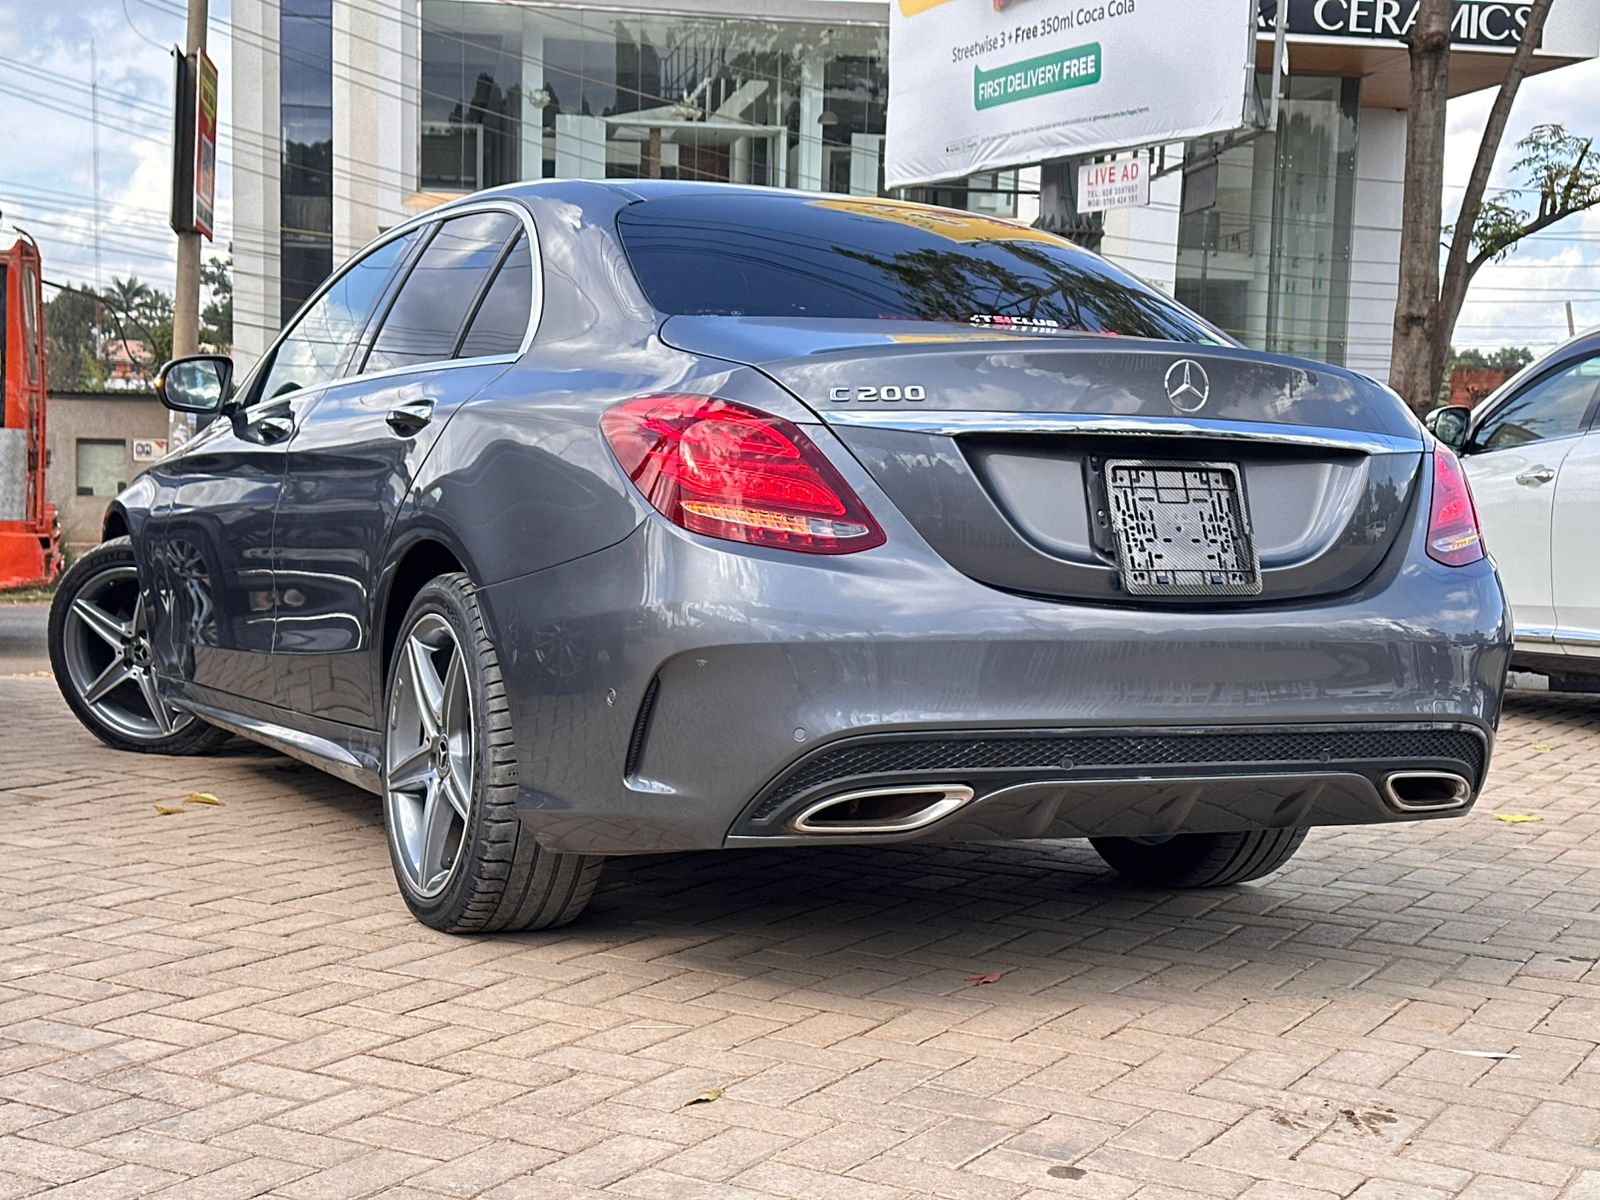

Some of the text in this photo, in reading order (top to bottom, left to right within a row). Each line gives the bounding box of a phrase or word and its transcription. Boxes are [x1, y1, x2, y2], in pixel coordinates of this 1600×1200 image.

[952, 0, 1135, 63] Streetwise 3 + Free 350ml Coca Cola
[978, 54, 1096, 101] FIRST DELIVERY FREE
[1087, 163, 1139, 186] LIVE AD
[829, 385, 926, 402] C 200
